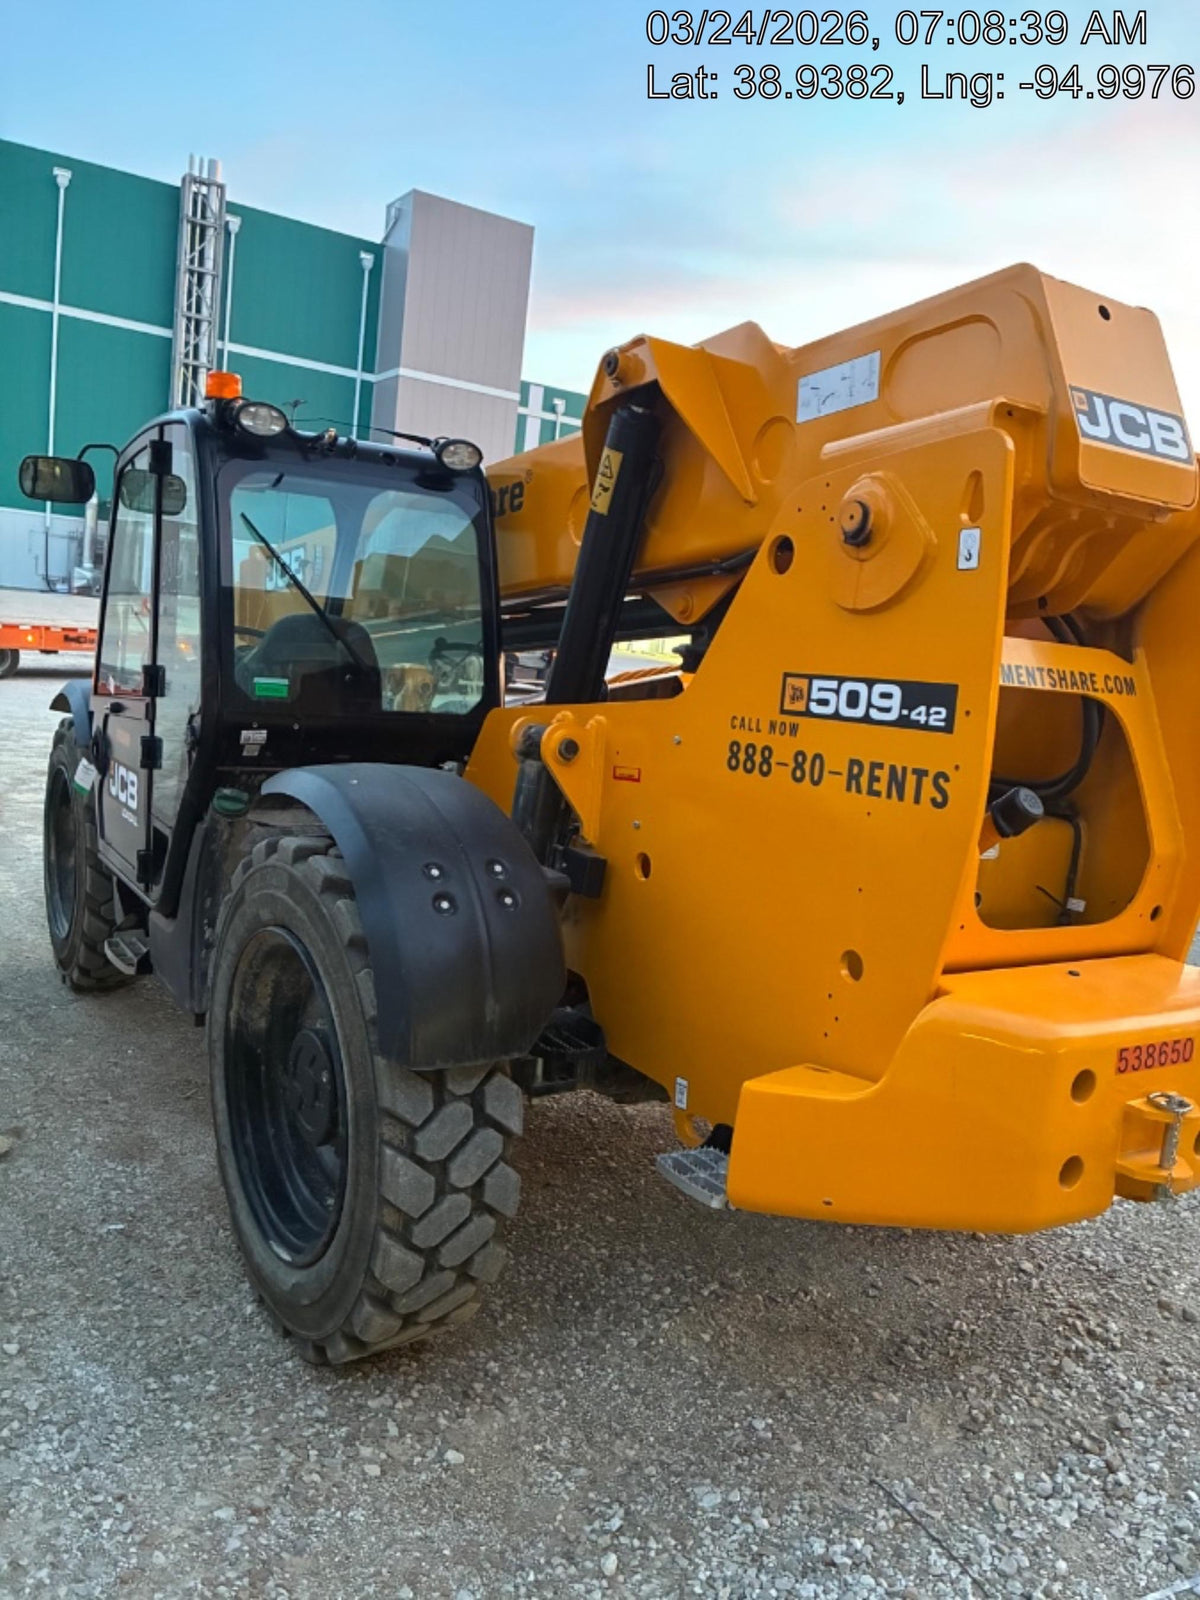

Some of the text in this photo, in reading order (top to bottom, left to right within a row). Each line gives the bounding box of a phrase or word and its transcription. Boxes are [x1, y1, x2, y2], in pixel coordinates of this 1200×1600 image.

[1078, 396, 1189, 460] JCB
[730, 715, 800, 737] CALL NOW
[808, 678, 948, 727] 509-42
[109, 762, 138, 810] JCB
[726, 740, 951, 810] 888-80-RENTS
[1117, 1037, 1195, 1074] 538650
